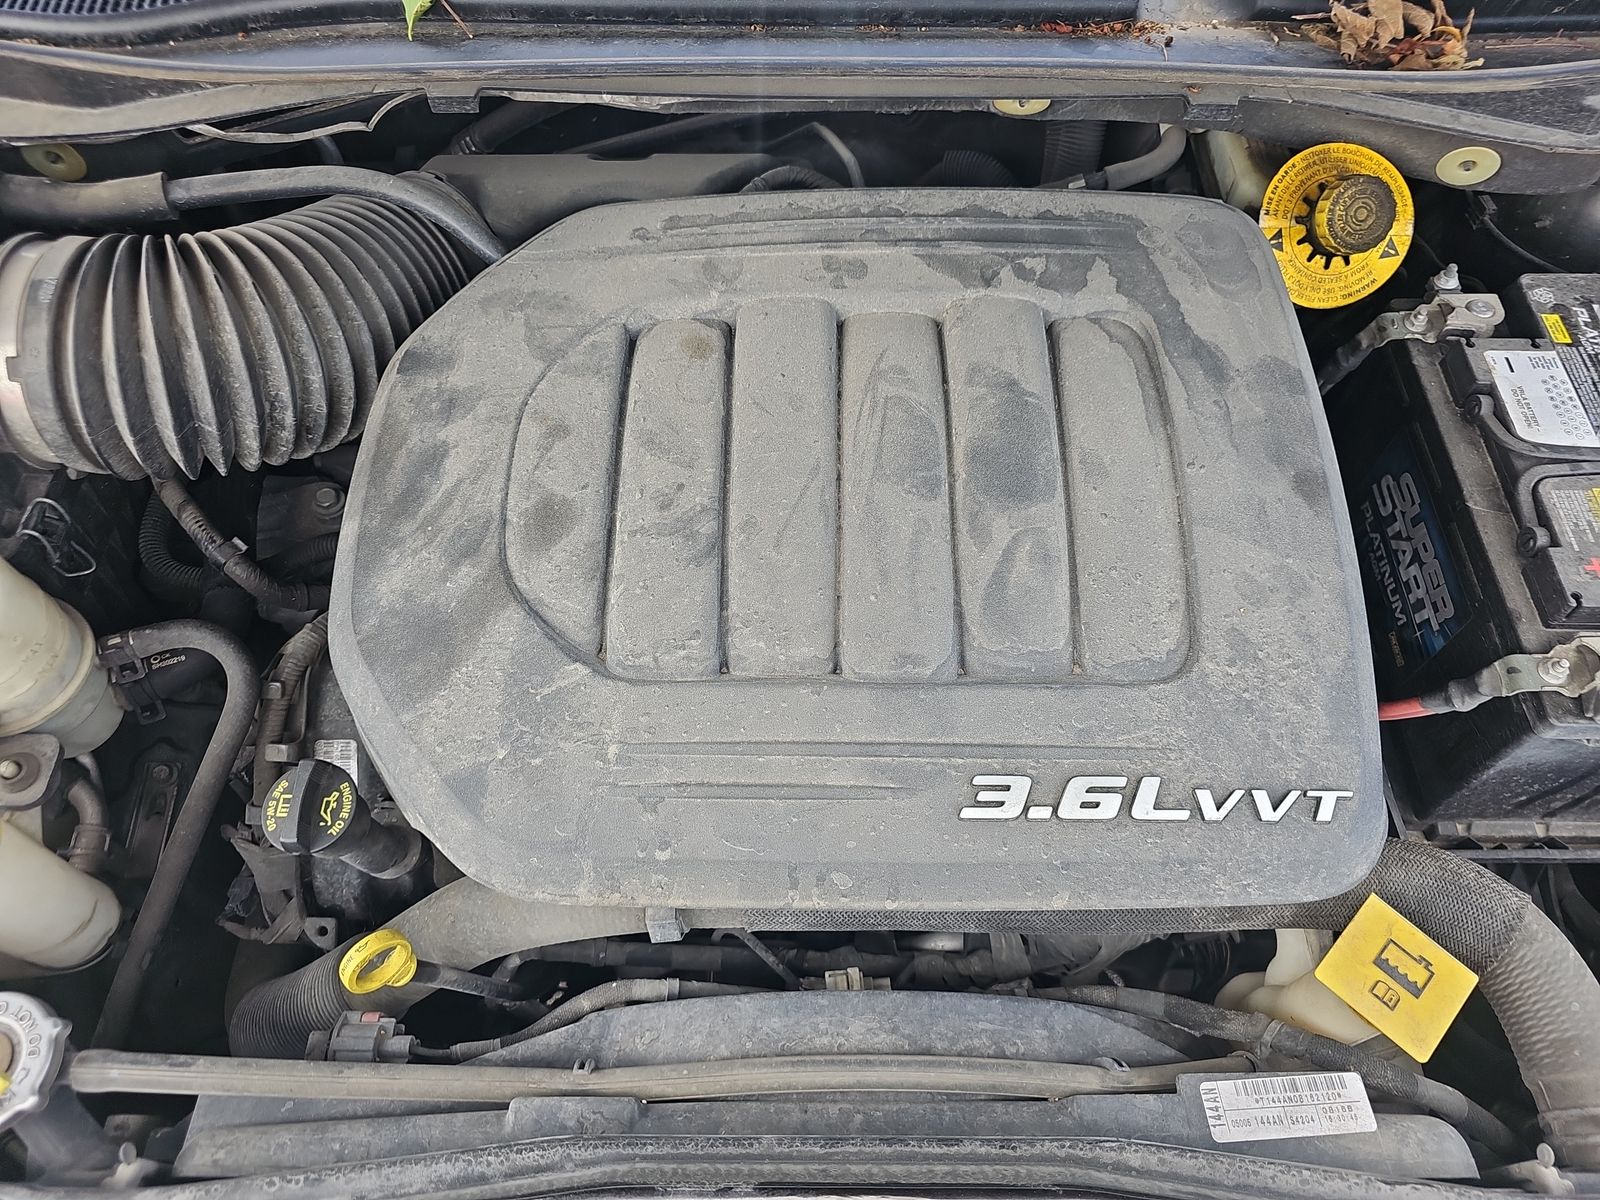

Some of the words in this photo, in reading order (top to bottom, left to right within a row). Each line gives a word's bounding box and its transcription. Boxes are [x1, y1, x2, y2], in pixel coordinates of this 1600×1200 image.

[1264, 196, 1275, 216] MISE
[1271, 184, 1280, 195] EN
[1300, 147, 1332, 163] NETTOYER
[1342, 147, 1375, 163] BOUCHON
[1374, 159, 1384, 170] DE
[1280, 184, 1290, 195] DE
[1286, 177, 1295, 186] LE
[1282, 205, 1291, 220] DOT
[1289, 168, 1321, 199] PROVENANT
[1317, 275, 1344, 284] SEALED
[1350, 261, 1369, 278] FROM
[1317, 295, 1339, 303] CLEAN
[1322, 287, 1336, 295] USE
[1511, 388, 1519, 398] DO
[1515, 398, 1525, 410] NOT
[1517, 385, 1528, 401] VRLA
[1523, 402, 1540, 427] BATTERY
[1372, 474, 1440, 632] START
[1399, 472, 1455, 624] SUPER
[1360, 501, 1407, 626] PLATINUM
[272, 780, 289, 799] SAE
[339, 782, 353, 819] ENGINE
[959, 774, 1193, 822] 3.6L
[1193, 788, 1354, 824] VVT
[266, 800, 277, 832] 5W-20
[327, 820, 345, 836] OIL
[341, 955, 354, 976] ENGINE
[10, 1005, 37, 1034] NOT
[1201, 1087, 1226, 1129] 144AN
[1254, 1114, 1284, 1127] 144AN
[1290, 1116, 1316, 1126] S4204
